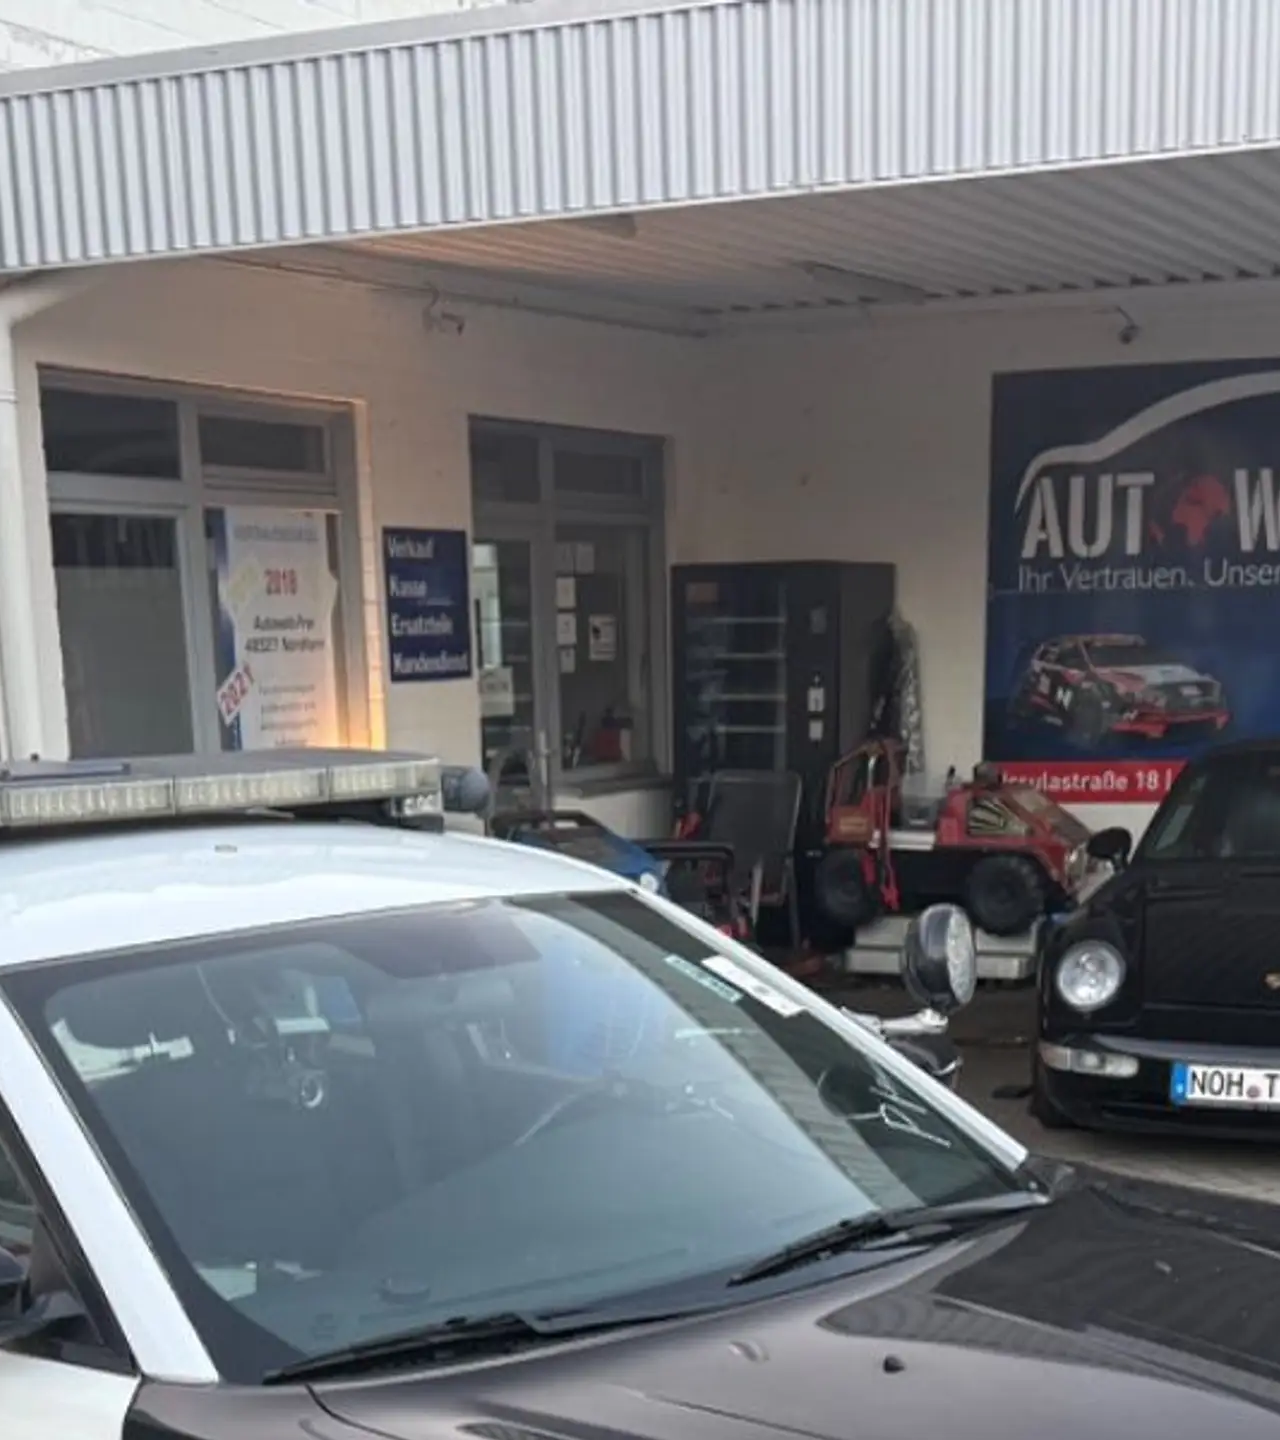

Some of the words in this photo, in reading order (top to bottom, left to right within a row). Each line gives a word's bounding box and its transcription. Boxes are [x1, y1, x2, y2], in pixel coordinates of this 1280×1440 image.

[1019, 565, 1053, 592] Ihr
[1061, 563, 1195, 591] Vertrauen.
[1135, 770, 1159, 790] 18
[1191, 1071, 1244, 1097] NOH
[1264, 1073, 1280, 1099] T
